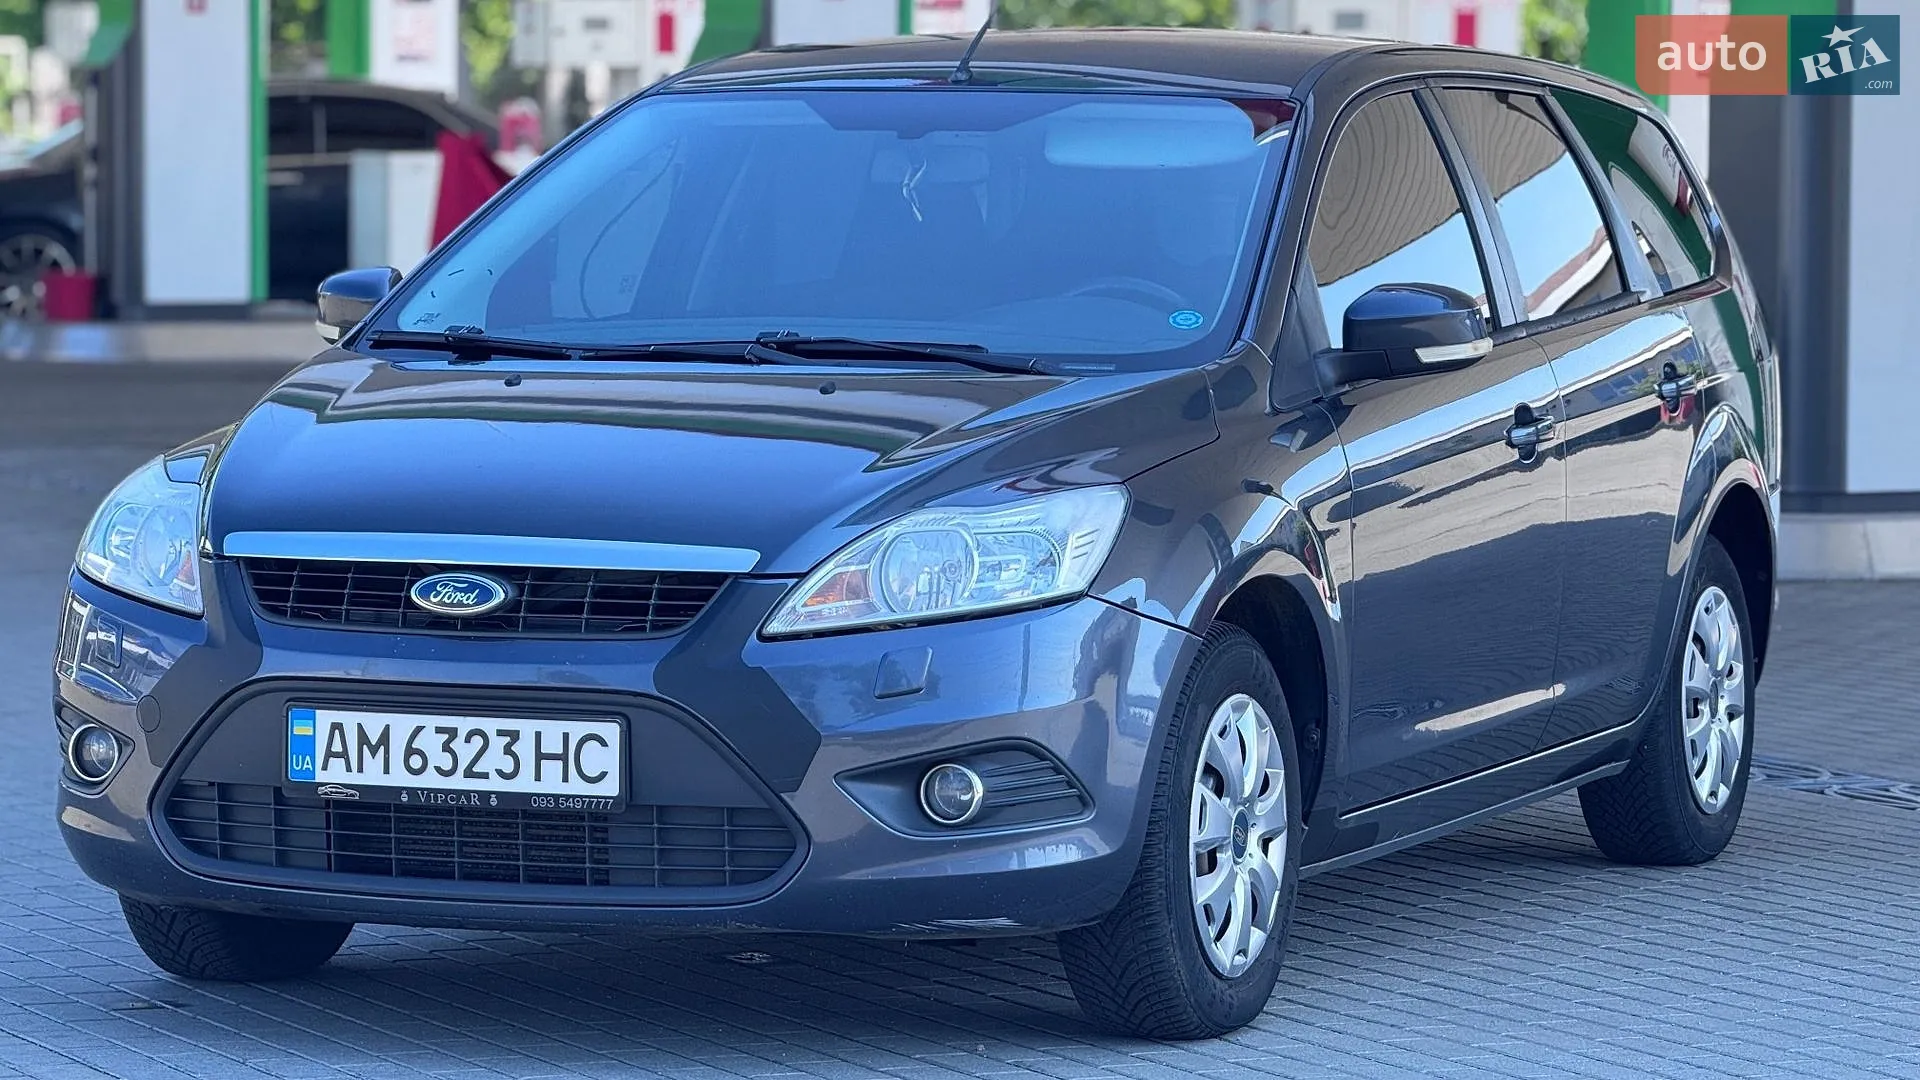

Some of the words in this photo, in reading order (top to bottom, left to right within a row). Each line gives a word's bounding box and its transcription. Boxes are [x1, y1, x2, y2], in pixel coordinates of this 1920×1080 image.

[430, 581, 479, 604] Ford
[293, 754, 313, 771] UA
[321, 722, 390, 774] AM
[403, 725, 520, 780] 6323
[534, 731, 609, 784] HC
[531, 796, 555, 808] 093
[558, 797, 614, 810] 5497777
